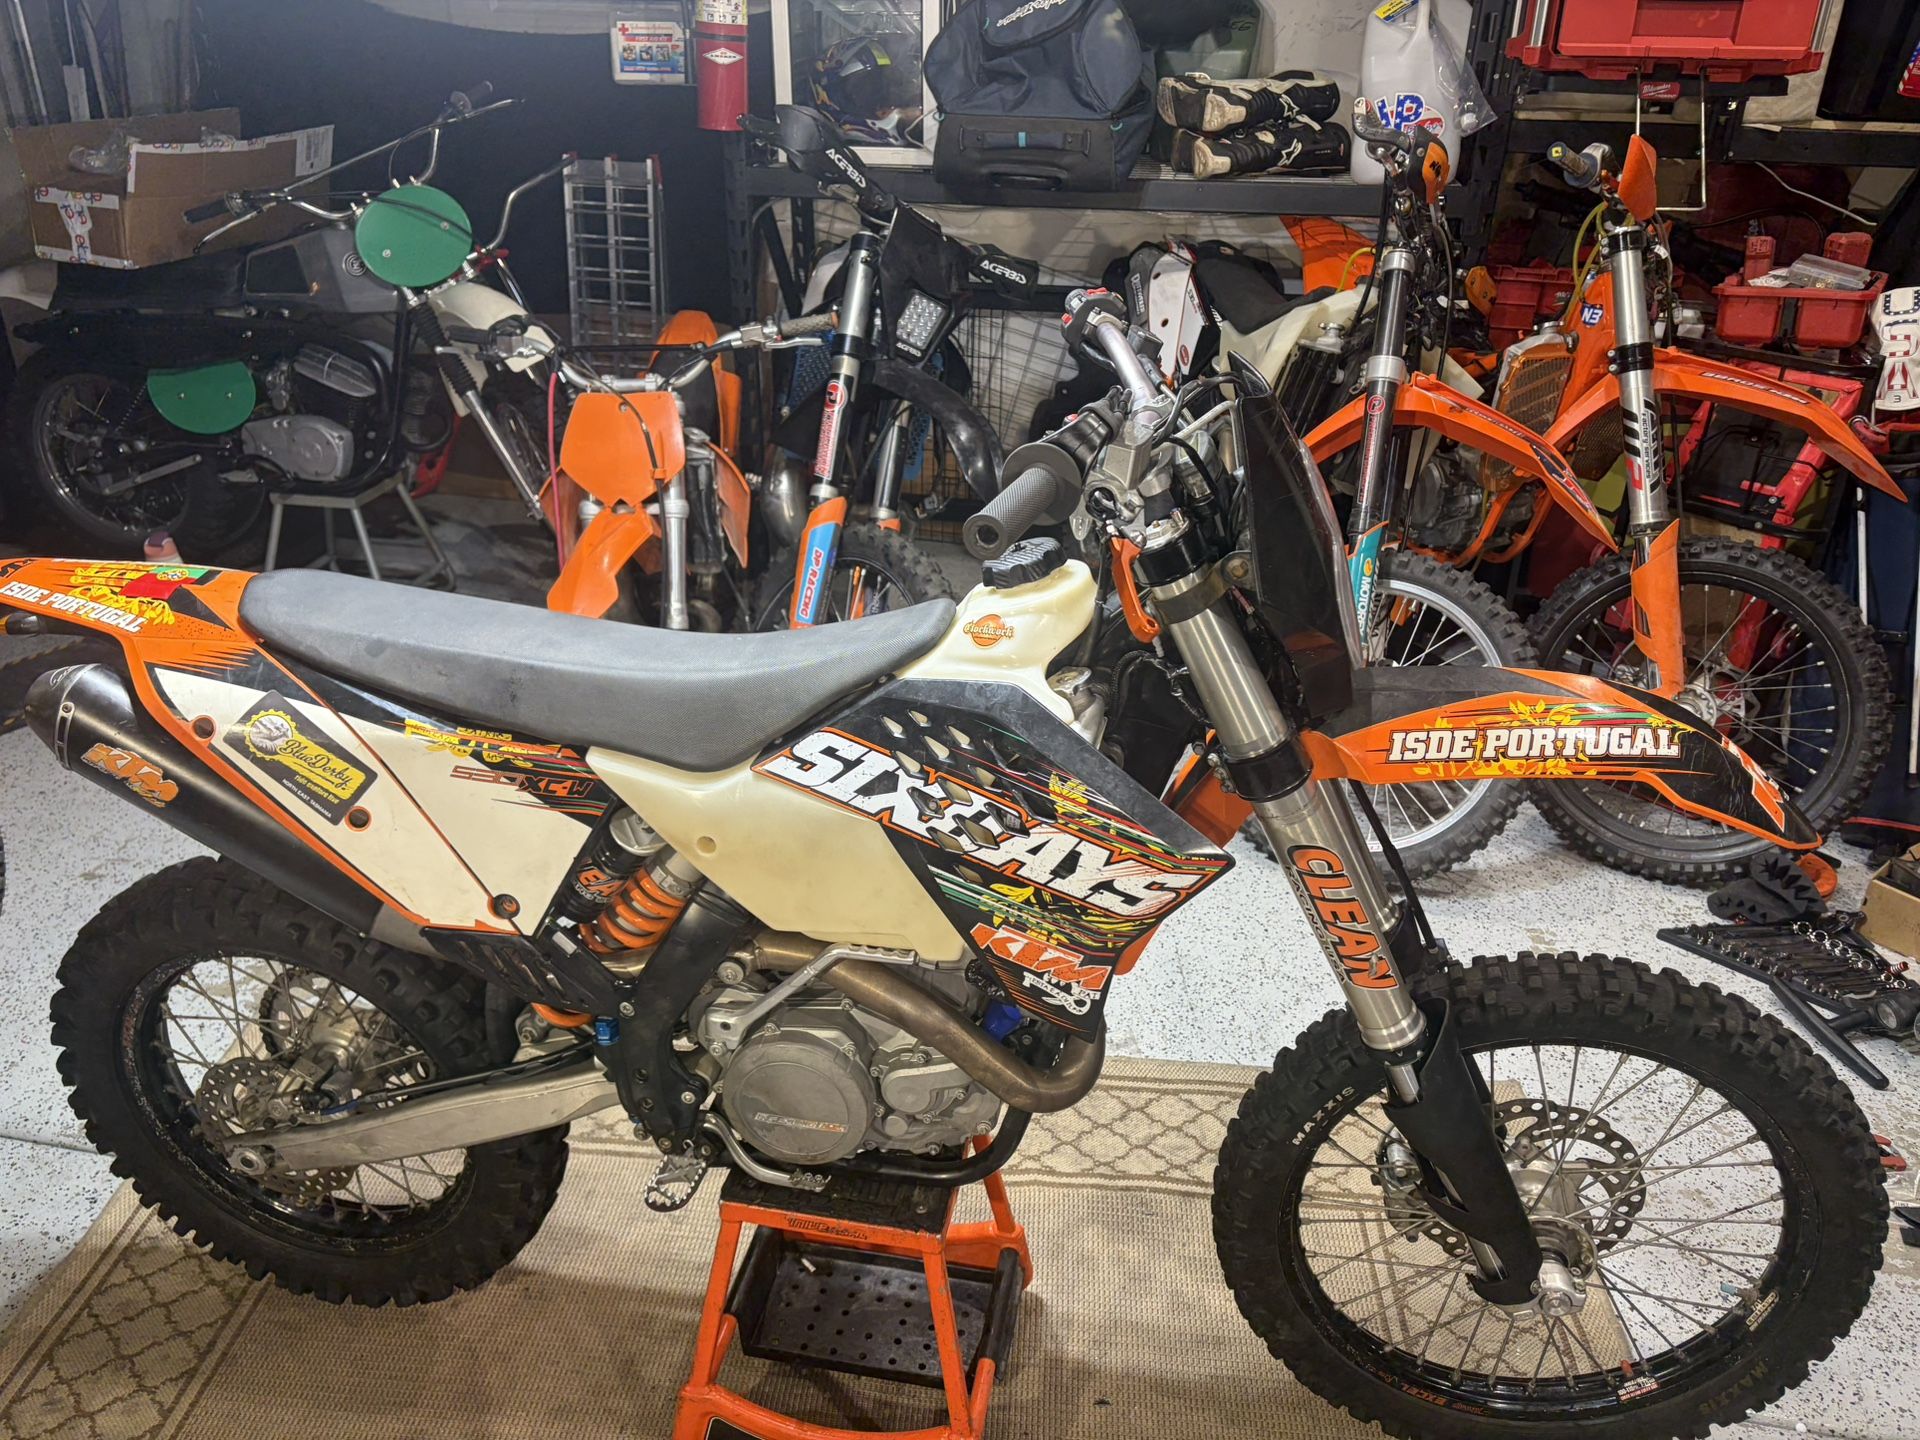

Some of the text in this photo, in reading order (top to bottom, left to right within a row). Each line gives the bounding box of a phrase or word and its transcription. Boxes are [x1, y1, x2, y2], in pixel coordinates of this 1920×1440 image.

[979, 259, 1027, 285] ACERBIS
[0, 581, 149, 633] ISDE PORTUGAL
[799, 567, 819, 618] RACING
[1387, 727, 1681, 762] ISDE PORTUGAL
[82, 743, 179, 802] KTM
[282, 778, 298, 792] NORTH
[297, 790, 310, 801] EAST
[1285, 865, 1325, 939] RACING
[1287, 844, 1400, 990] CLEAN
[970, 923, 1112, 990] KTM
[1292, 1087, 1355, 1145] MAXXIS
